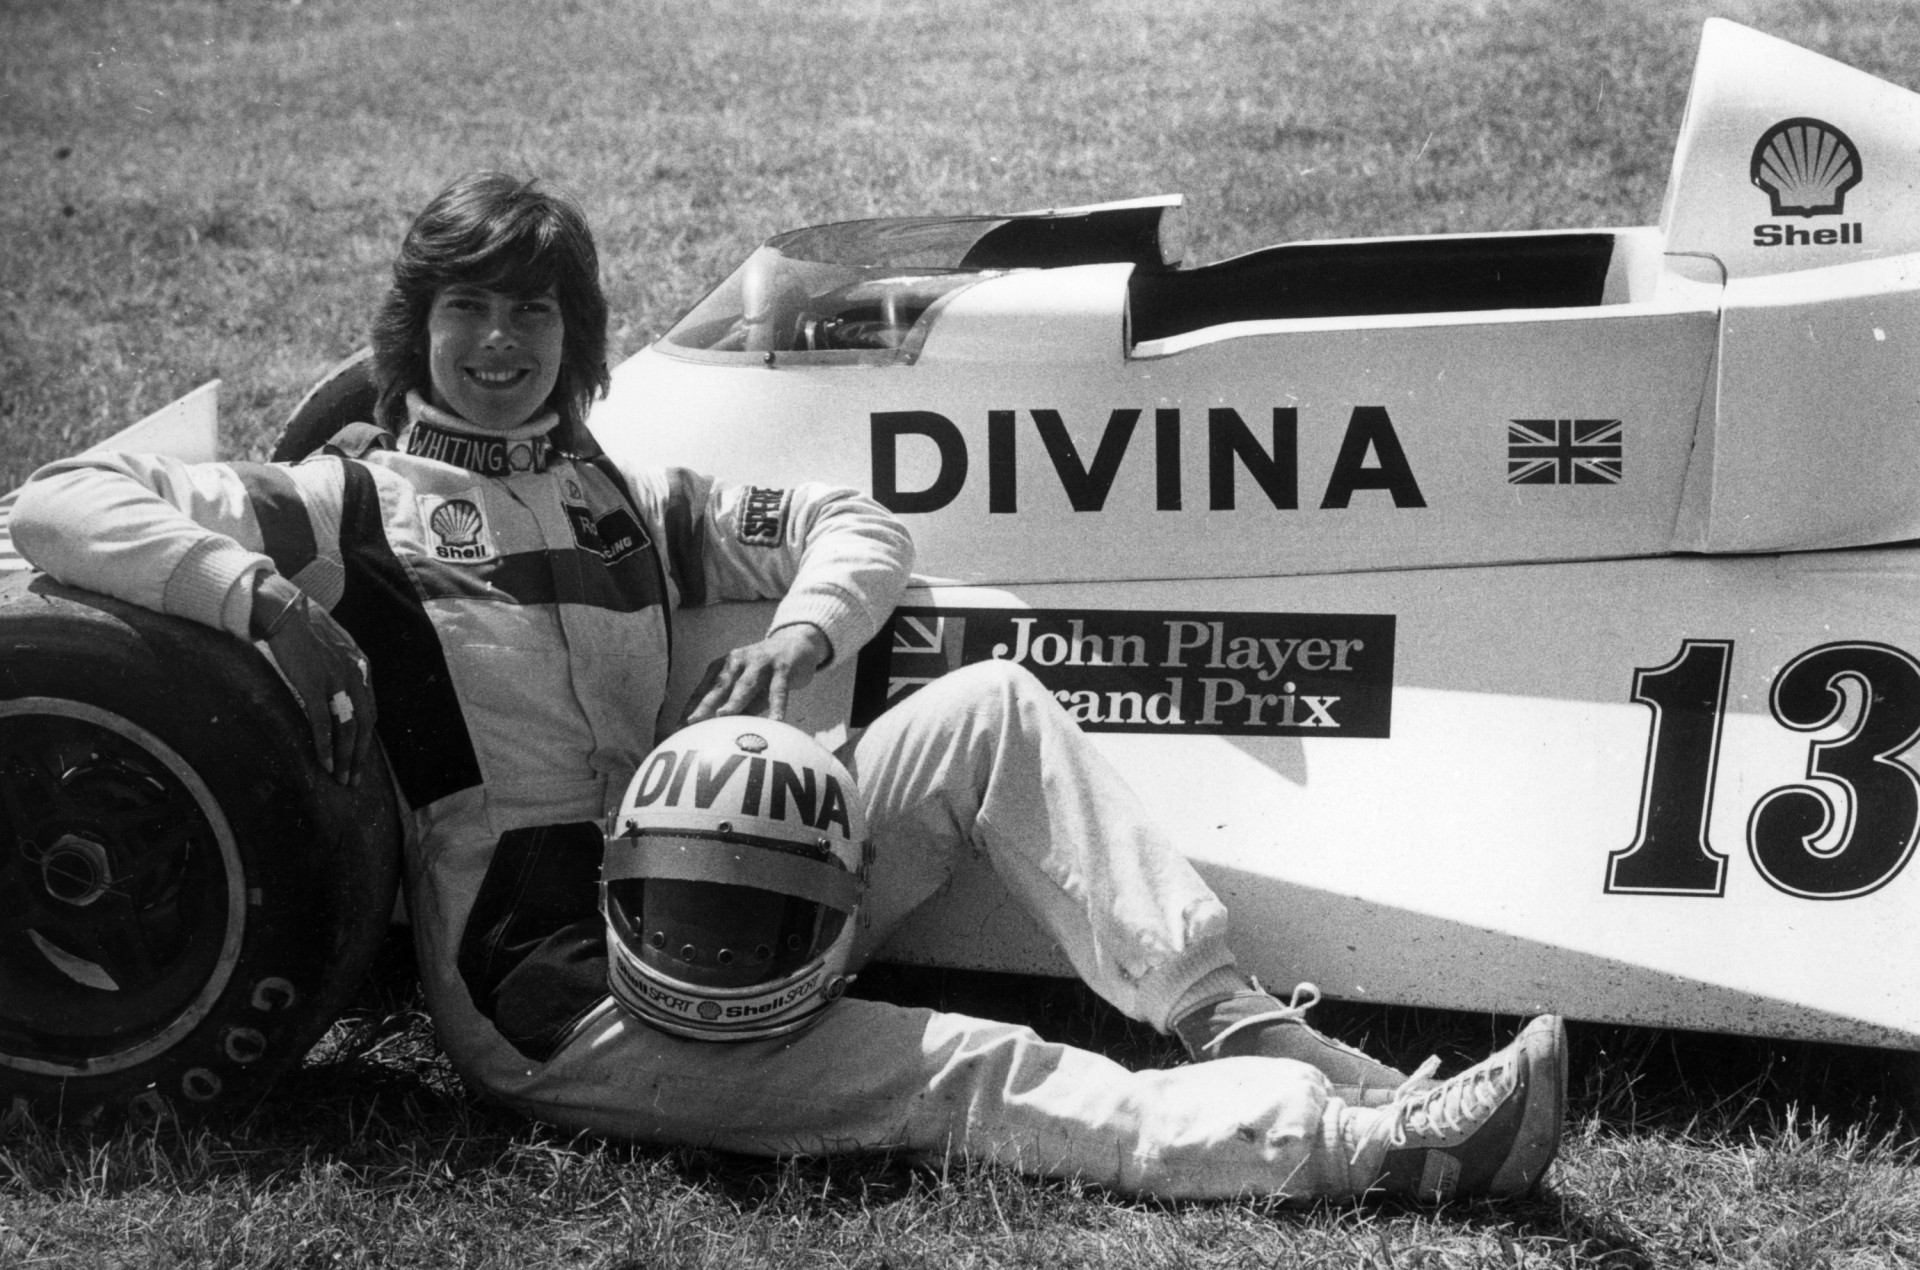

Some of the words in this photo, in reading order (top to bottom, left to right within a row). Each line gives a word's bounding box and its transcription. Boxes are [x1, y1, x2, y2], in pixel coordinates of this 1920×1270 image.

[1753, 222, 1862, 246] Shell
[410, 425, 505, 471] WHITING
[870, 405, 1428, 514] DIVINA
[435, 545, 486, 559] Shell
[991, 617, 1149, 667] John
[1159, 620, 1364, 680] Player
[1046, 677, 1186, 725] rand
[1195, 680, 1341, 728] Prix
[634, 750, 850, 840] DIVINA
[1603, 639, 1920, 901] 13
